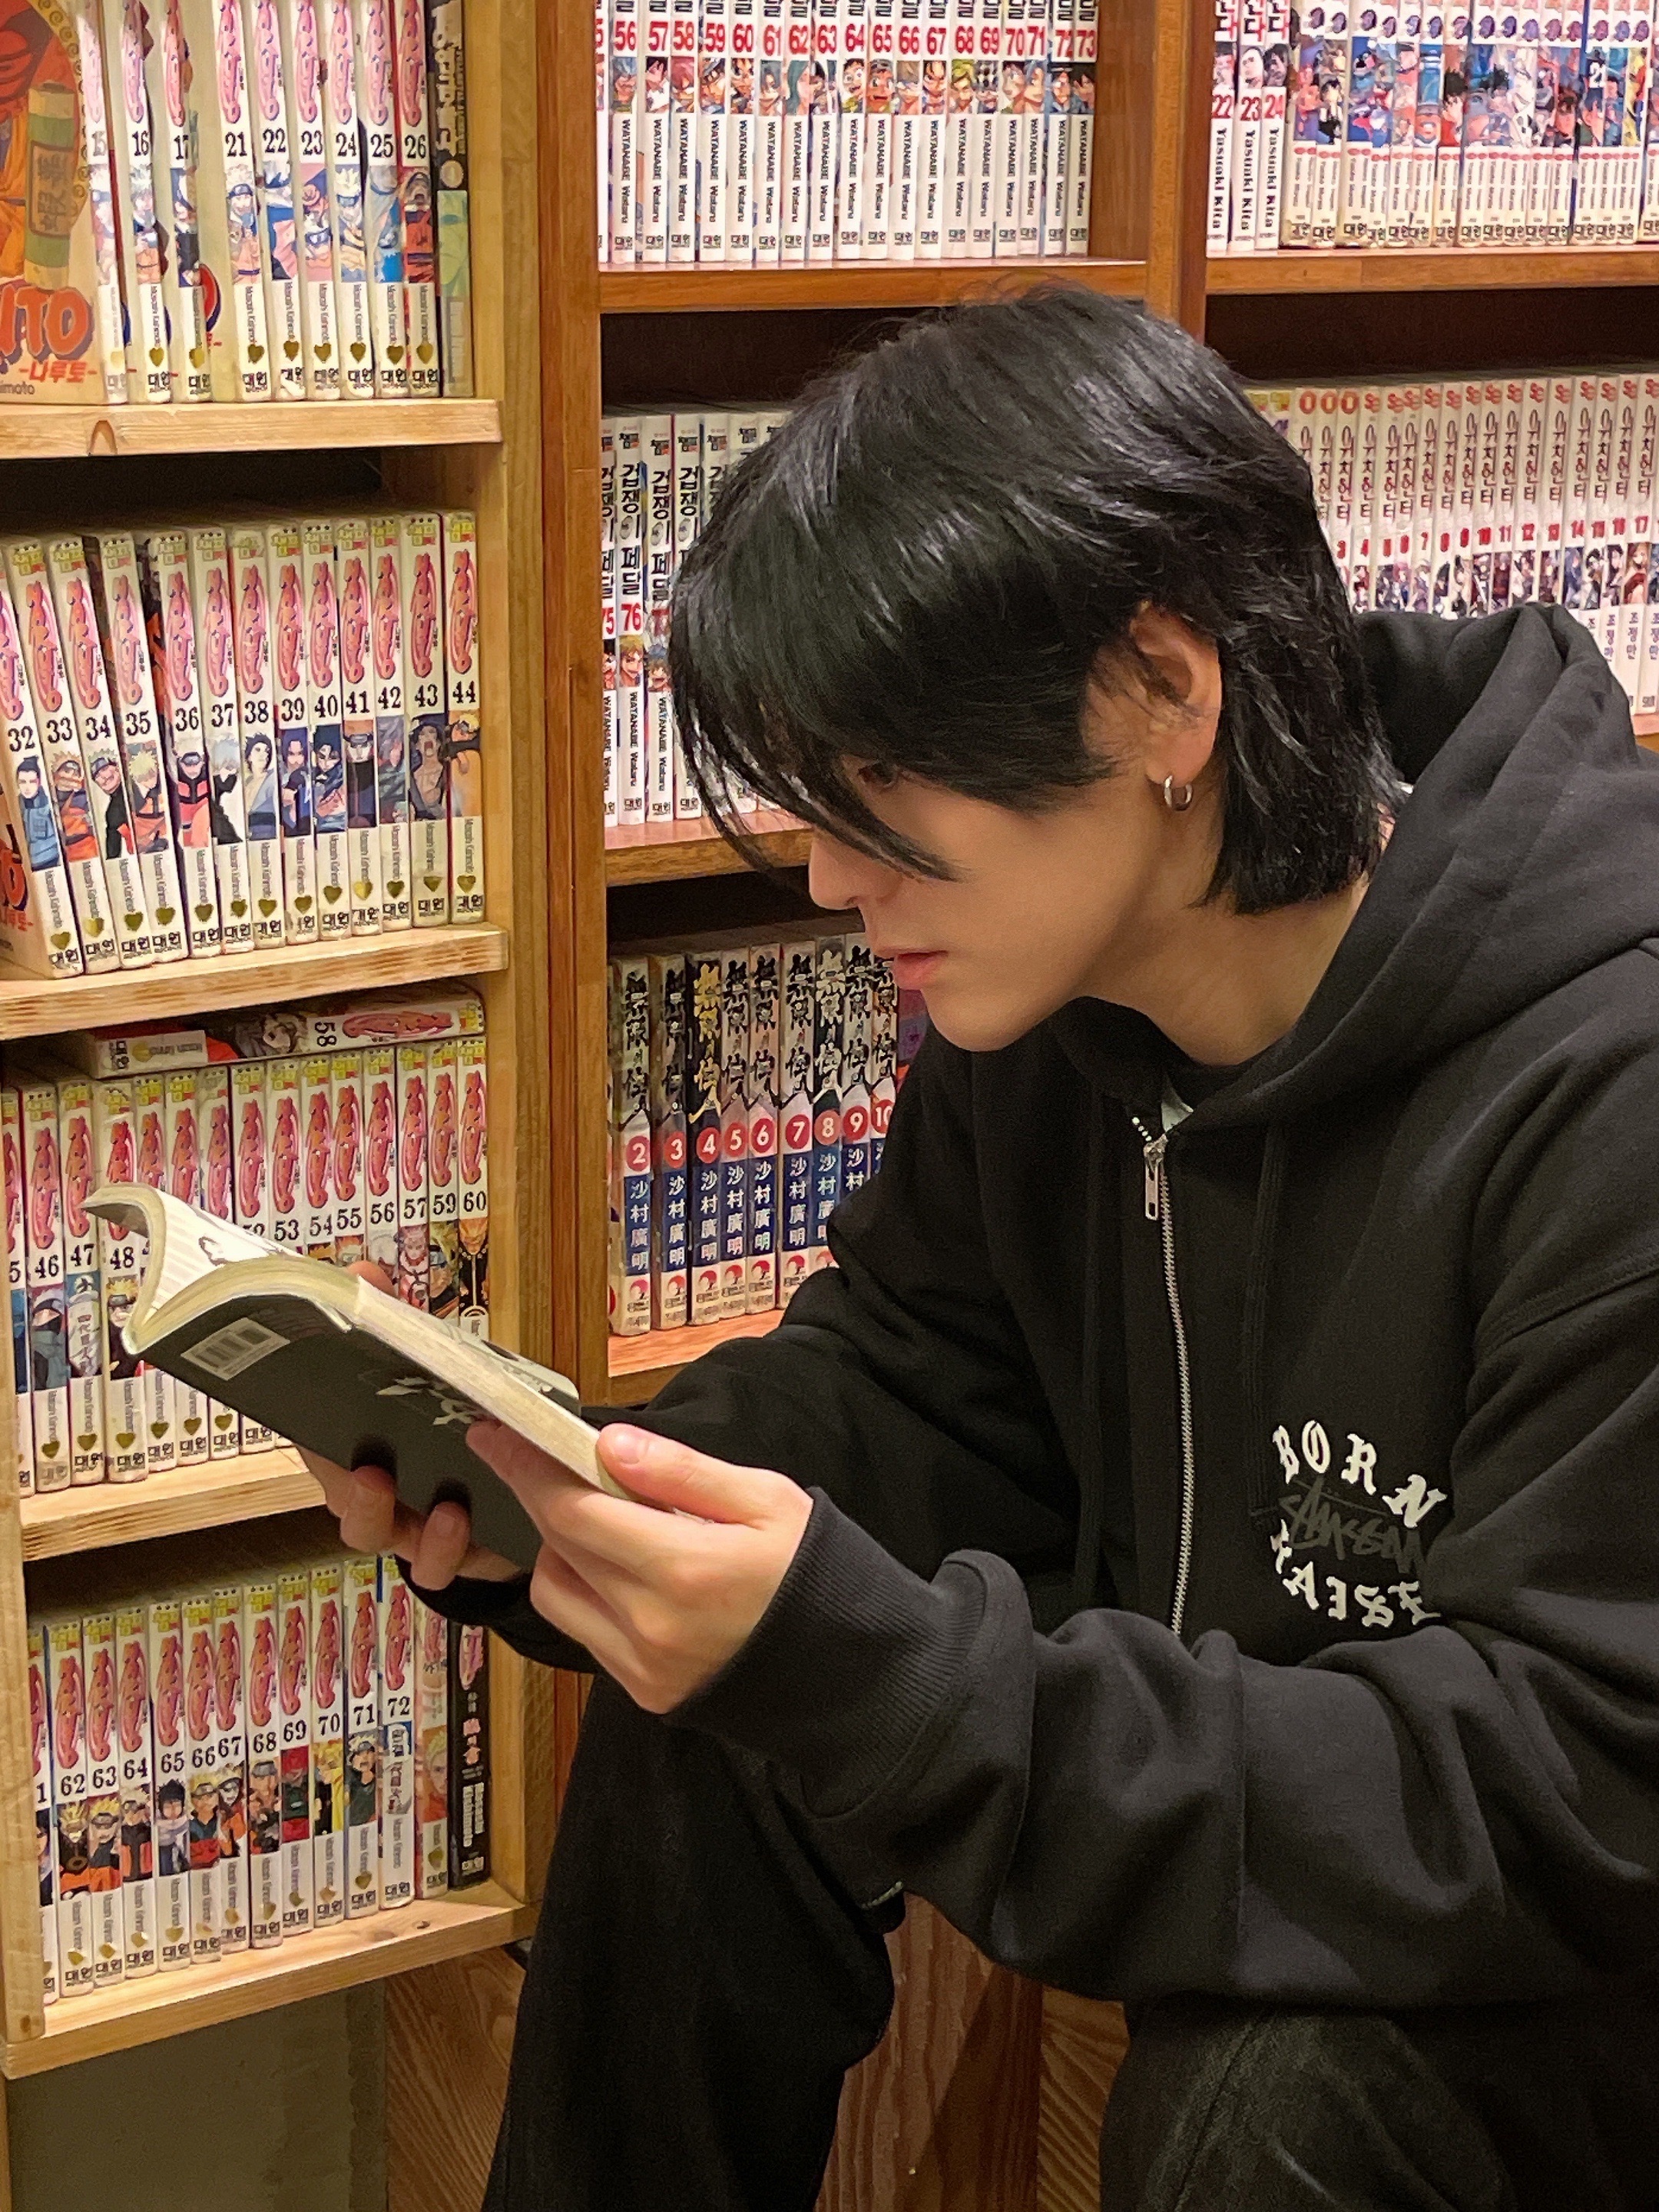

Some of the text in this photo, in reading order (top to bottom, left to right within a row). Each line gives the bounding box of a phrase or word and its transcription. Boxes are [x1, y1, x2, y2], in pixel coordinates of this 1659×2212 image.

[615, 21, 636, 51] 56
[649, 21, 668, 51] 57
[674, 21, 694, 50] 58
[706, 22, 725, 52] 59
[733, 23, 754, 53] 60
[763, 25, 781, 56] 61
[790, 24, 808, 55] 62
[818, 24, 837, 54] 63
[845, 23, 864, 52] 64
[873, 25, 892, 54] 65
[899, 25, 920, 55] 66
[926, 27, 946, 55] 67
[955, 25, 974, 55] 68
[982, 26, 999, 55] 69
[1005, 28, 1025, 56] 70
[1027, 26, 1045, 56] 71
[1055, 29, 1074, 58] 72
[1077, 29, 1097, 58] 73
[1213, 94, 1231, 118] 22
[1241, 96, 1260, 121] 23
[1265, 94, 1283, 118] 24
[91, 131, 107, 156] 15
[132, 131, 149, 156] 16
[174, 134, 189, 160] 17
[225, 131, 247, 157] 21
[263, 128, 286, 154] 22
[301, 130, 323, 155] 23
[336, 132, 356, 157] 24
[370, 134, 393, 158] 25
[405, 134, 426, 159] 26
[678, 465, 699, 542] 겁쟁이
[619, 462, 641, 595] 겁쟁이 페달
[651, 469, 671, 601] 겁쟁이 페달
[1499, 525, 1512, 542] 11
[621, 602, 641, 631] 76
[346, 691, 369, 714] 41
[378, 686, 401, 710] 42
[415, 684, 438, 707] 43
[452, 680, 476, 704] 44
[211, 703, 234, 727] 37
[244, 700, 269, 724] 38
[281, 697, 305, 722] 39
[315, 694, 338, 717] 40
[47, 717, 72, 743] 33
[85, 714, 111, 740] 34
[126, 710, 151, 737] 35
[176, 707, 199, 731] 36
[8, 726, 35, 752] 32
[314, 1021, 336, 1048] 58
[822, 1117, 833, 1137] 8
[849, 1112, 863, 1132] 9
[876, 1106, 892, 1127] 10
[702, 1134, 715, 1154] 4
[730, 1129, 742, 1150] 5
[757, 1124, 769, 1145] 6
[792, 1121, 805, 1142] 7
[633, 1143, 645, 1164] 2
[671, 1138, 683, 1161] 3
[846, 1148, 865, 1191] 沙村
[370, 1202, 394, 1224] 56
[404, 1197, 427, 1219] 57
[433, 1192, 456, 1215] 59
[464, 1190, 486, 1212] 60
[727, 1165, 744, 1255] 沙村廣明
[754, 1161, 772, 1250] 沙村廣明
[789, 1157, 806, 1246] 沙村廣明
[310, 1214, 333, 1237] 54
[336, 1207, 361, 1229] 55
[630, 1181, 648, 1270] 沙村廣明
[668, 1175, 685, 1266] 沙村廣明
[700, 1171, 718, 1260] 沙村廣明
[274, 1218, 299, 1241] 53
[35, 1254, 59, 1278] 46
[71, 1243, 94, 1267] 47
[110, 1247, 134, 1270] 48
[1272, 1419, 1448, 1528] BORN
[1270, 1518, 1442, 1627] RAISE
[354, 1703, 375, 1726] 71
[387, 1696, 410, 1717] 72
[283, 1720, 306, 1742] 69
[319, 1713, 340, 1736] 70
[218, 1736, 241, 1758] 67
[253, 1731, 276, 1753] 68
[124, 1758, 148, 1780] 64
[161, 1751, 184, 1773] 65
[192, 1746, 216, 1767] 66
[61, 1773, 85, 1796] 62
[93, 1767, 116, 1789] 63
